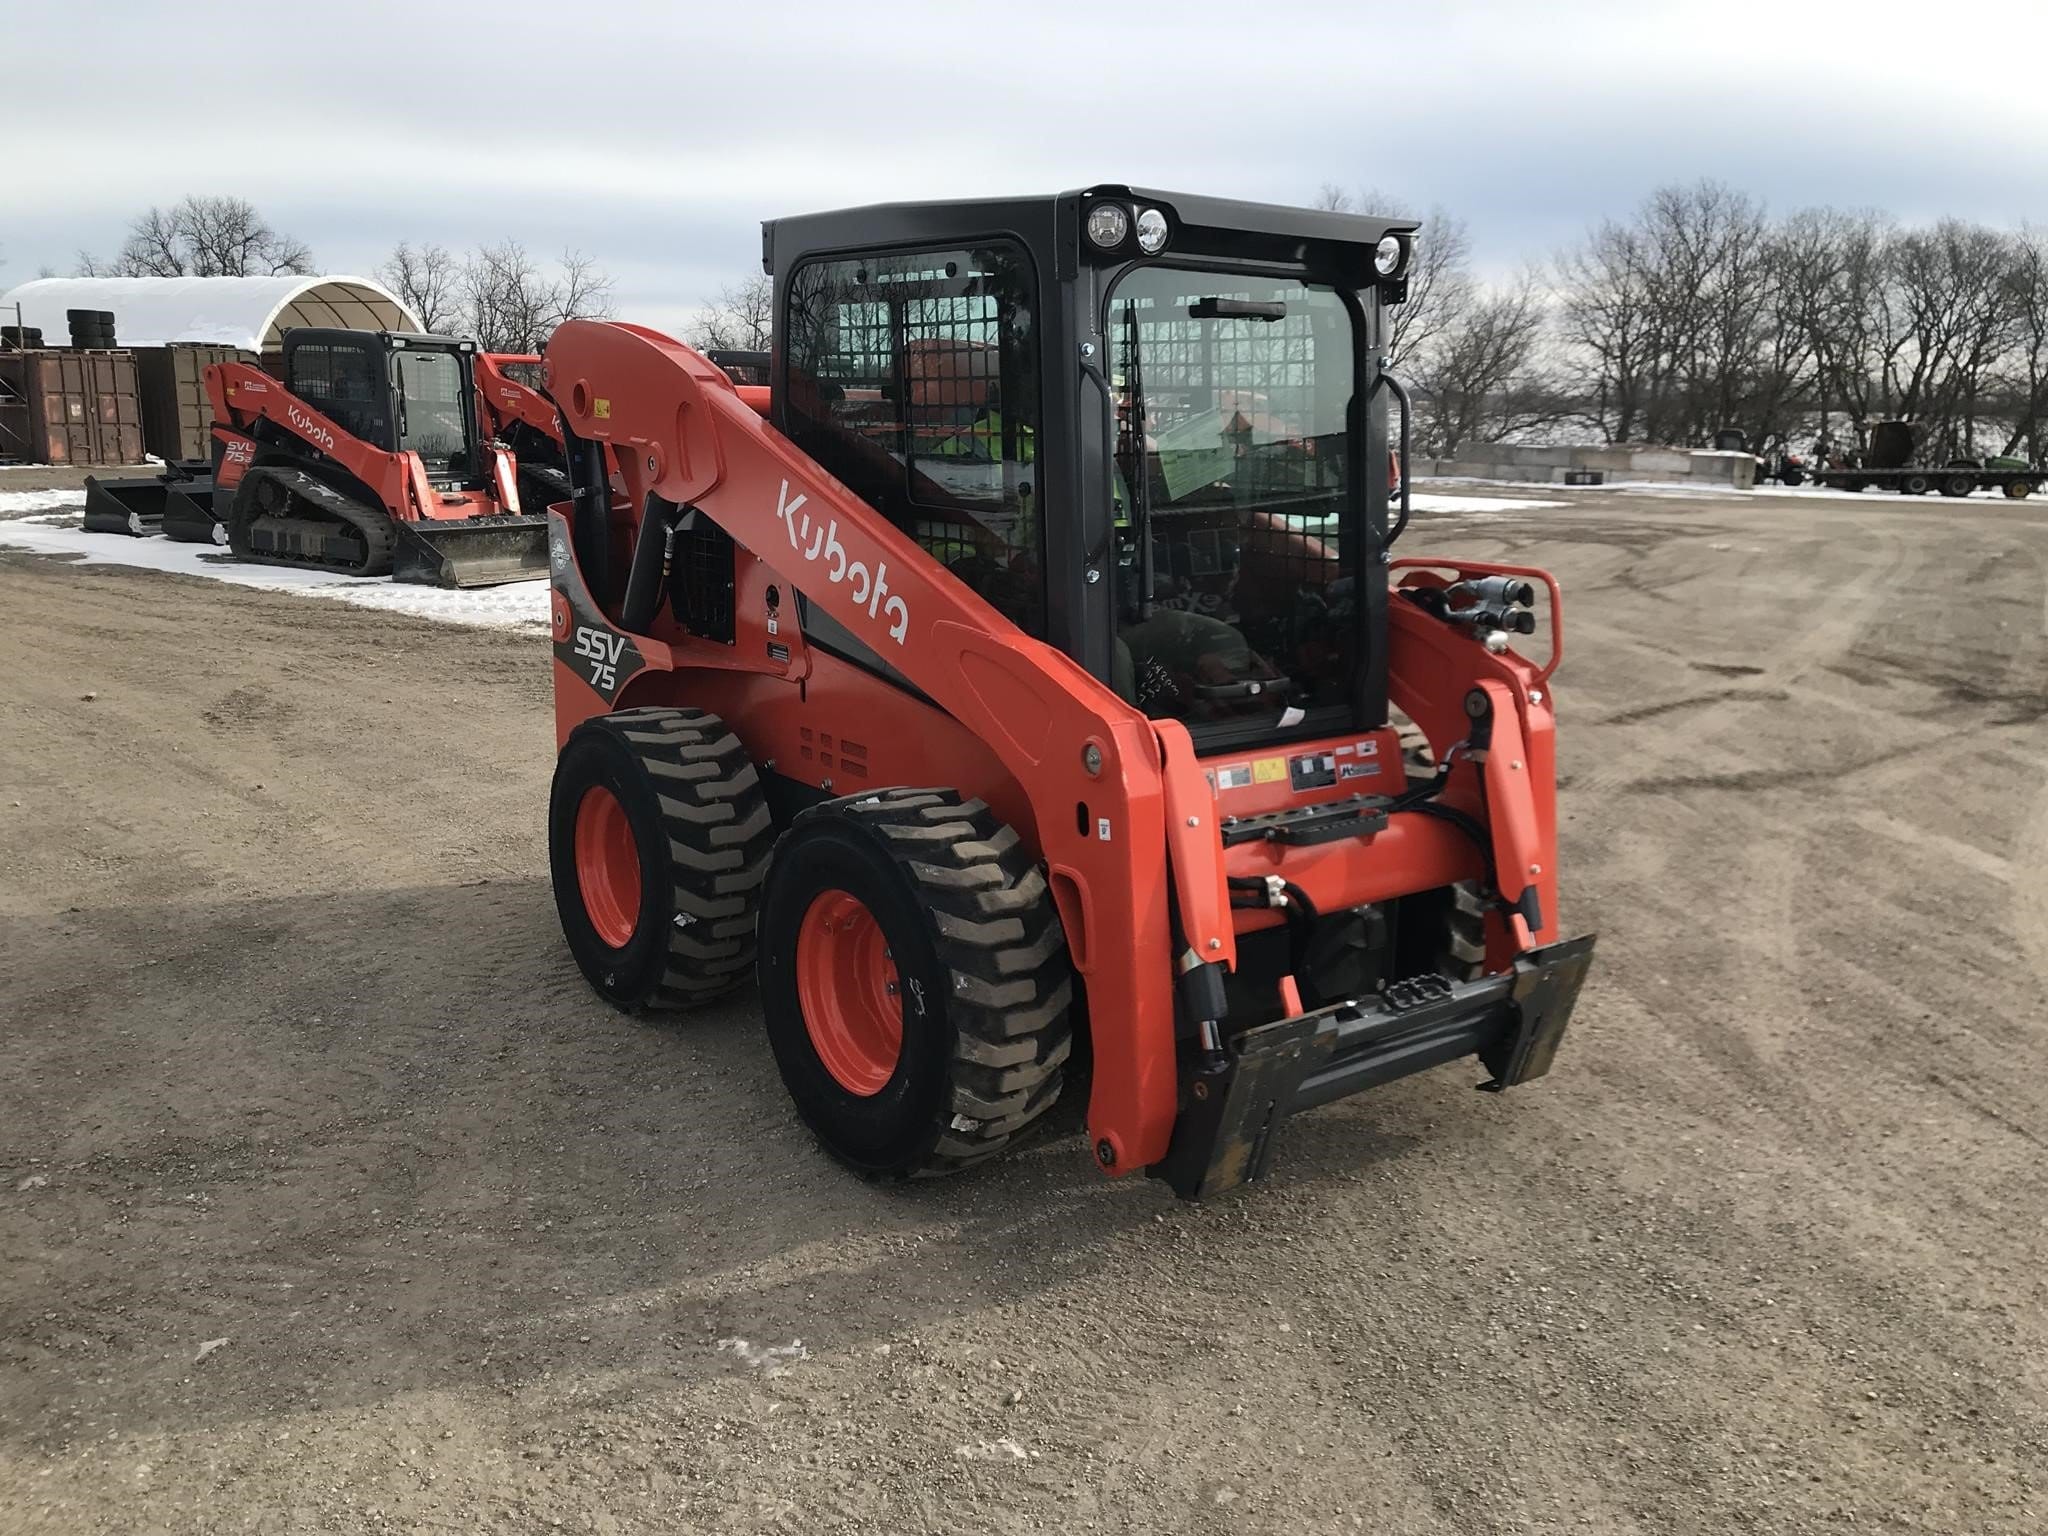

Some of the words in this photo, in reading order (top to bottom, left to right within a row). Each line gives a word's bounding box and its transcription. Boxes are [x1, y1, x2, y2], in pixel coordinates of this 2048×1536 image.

[227, 441, 255, 452] SVL
[288, 405, 334, 450] Kubota
[777, 478, 909, 646] Kubota
[574, 626, 626, 665] SSV
[590, 661, 617, 690] 75
